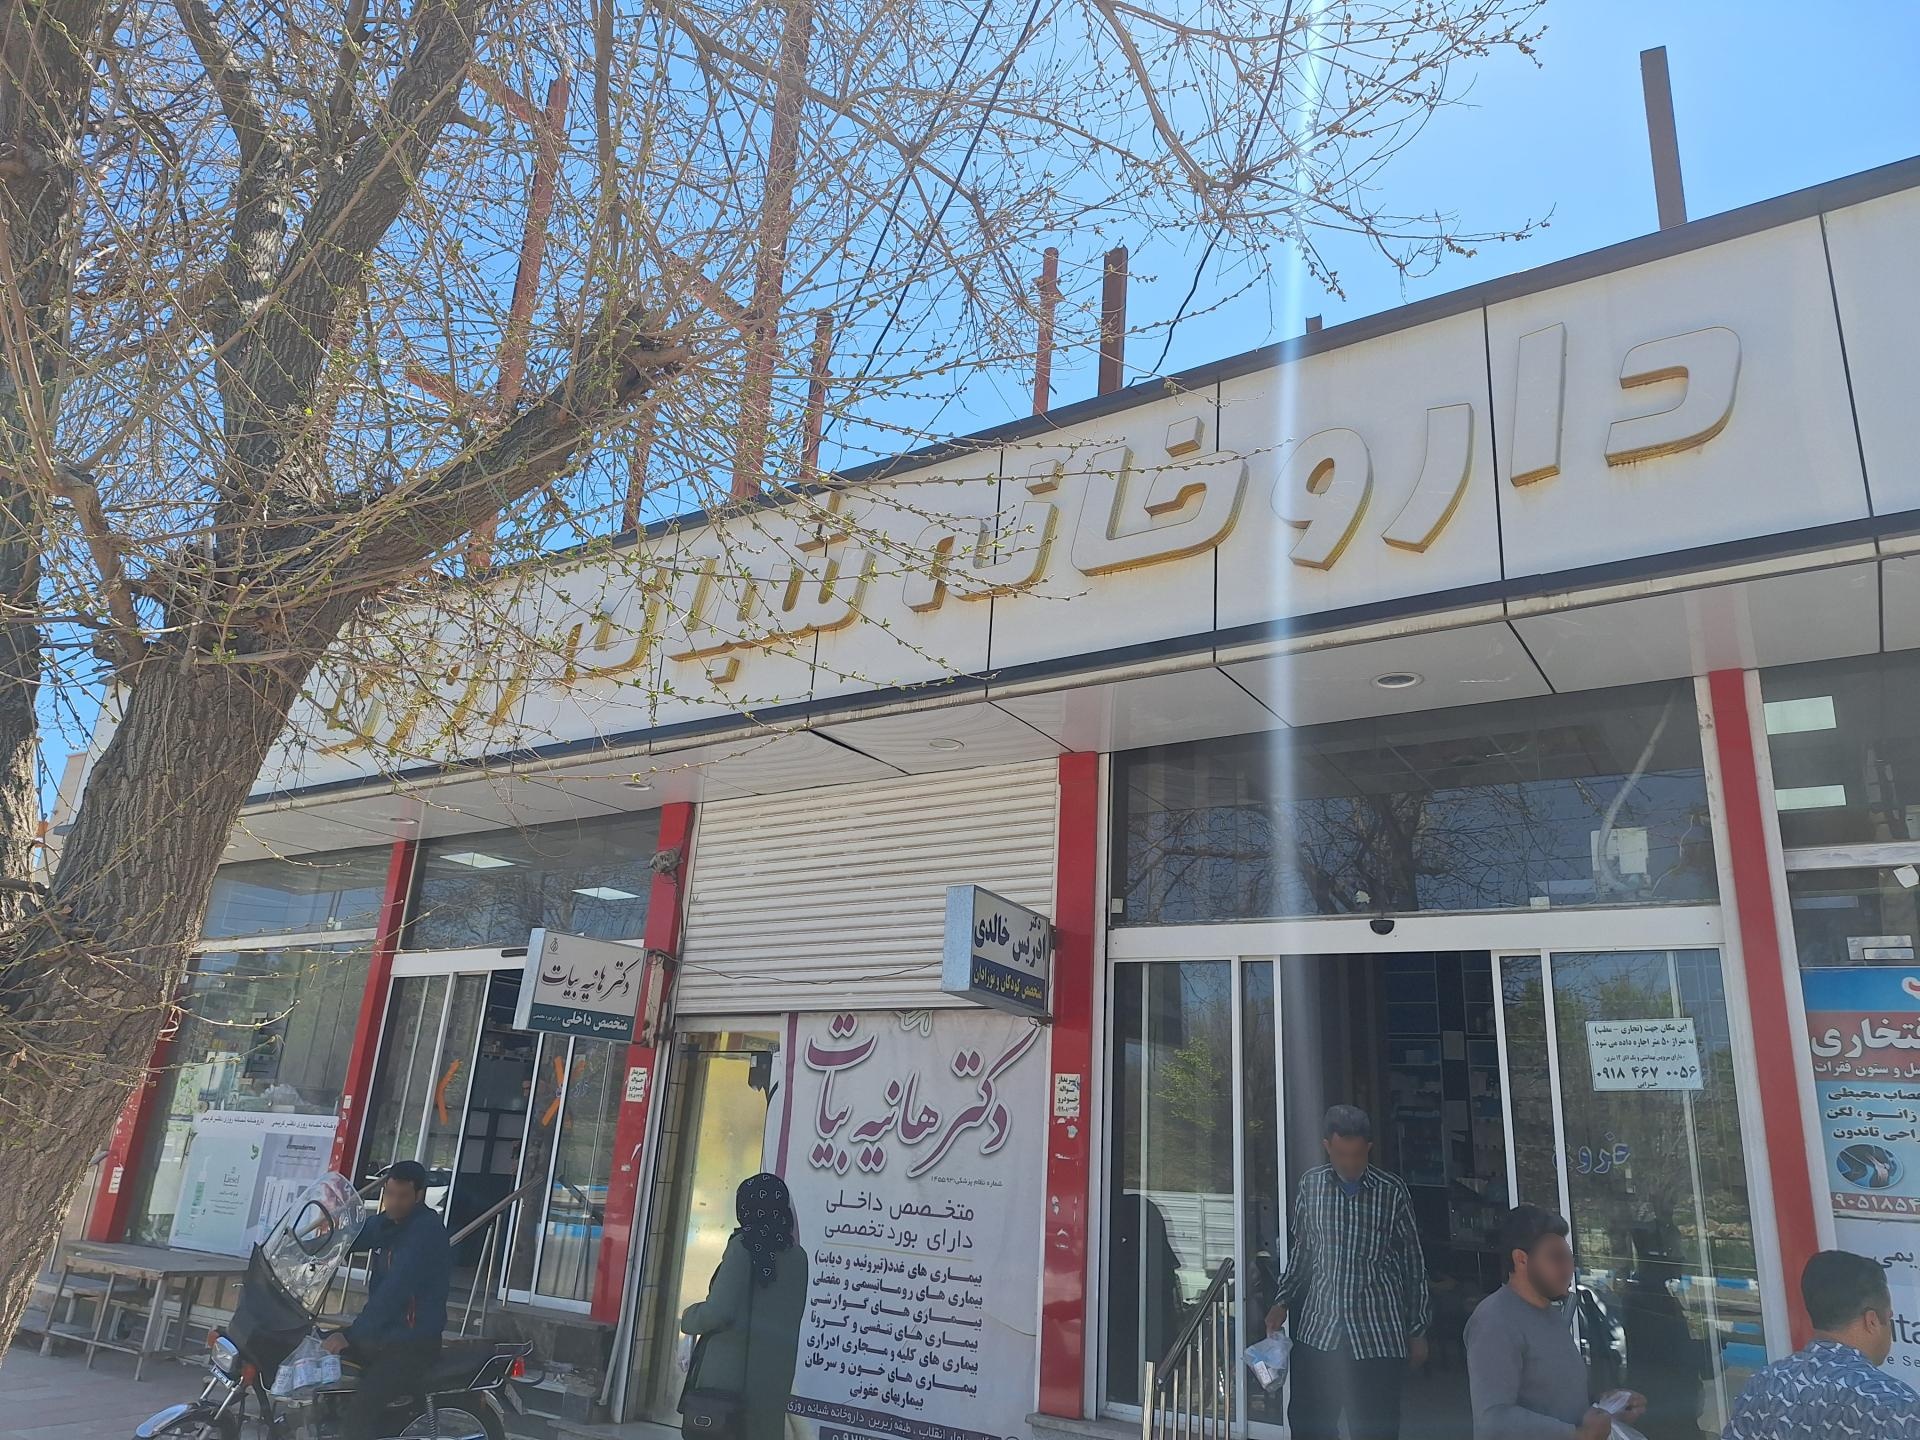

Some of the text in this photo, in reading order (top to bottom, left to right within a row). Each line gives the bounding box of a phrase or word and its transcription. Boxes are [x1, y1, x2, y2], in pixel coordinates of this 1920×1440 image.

[903, 322, 1742, 612] داروخانه
[556, 490, 876, 684] شبانه
[974, 912, 1045, 967] ادریس خالدی
[542, 958, 640, 1000] دکتر هانیه بیات
[1001, 973, 1020, 996] کودکان
[562, 1011, 591, 1027] داخلی
[592, 1017, 628, 1031] متخصص
[1811, 1018, 1920, 1057] تخاری
[1596, 1065, 1697, 1079] ۰۹۱۸ ۴۶۷ ۰۰۵۶
[1815, 1061, 1851, 1076] فقرات
[1855, 1063, 1888, 1077] ستون
[1893, 1067, 1901, 1077] و
[805, 1014, 1039, 1176] دکتر هانیه بیات
[1828, 1088, 1880, 1100] محیطی
[1833, 1126, 1920, 1142] احی تاندون
[826, 1189, 974, 1221] متخصص داخلی
[824, 1220, 973, 1252] دارای بورد تخصصی
[813, 1271, 841, 1286] مفصلی
[908, 1263, 927, 1279] های
[930, 1267, 982, 1287] بیماری
[852, 1278, 913, 1299] روماتیسمی
[915, 1285, 945, 1302] های
[870, 1299, 910, 1317] های
[948, 1290, 983, 1309] بیماری
[810, 1310, 850, 1329] کرونا
[860, 1320, 893, 1335] تنفسی
[913, 1307, 982, 1331] بیماری
[806, 1333, 840, 1349] ادراری
[894, 1325, 923, 1342] های
[925, 1331, 978, 1352] بیماری
[842, 1338, 887, 1355] مجاری
[896, 1347, 916, 1363] کلیه
[804, 1352, 837, 1372] سرطان
[919, 1351, 939, 1367] های
[942, 1355, 978, 1375] بیماری
[848, 1362, 885, 1376] خون
[887, 1367, 912, 1383] های
[849, 1381, 879, 1398] عفونی
[915, 1374, 977, 1397] بیماری
[787, 1399, 806, 1413] روزی
[807, 1403, 829, 1416] شبانه
[831, 1408, 865, 1423] داروخانه
[868, 1417, 893, 1431] زیرین
[919, 1426, 945, 1440] انقلاب
